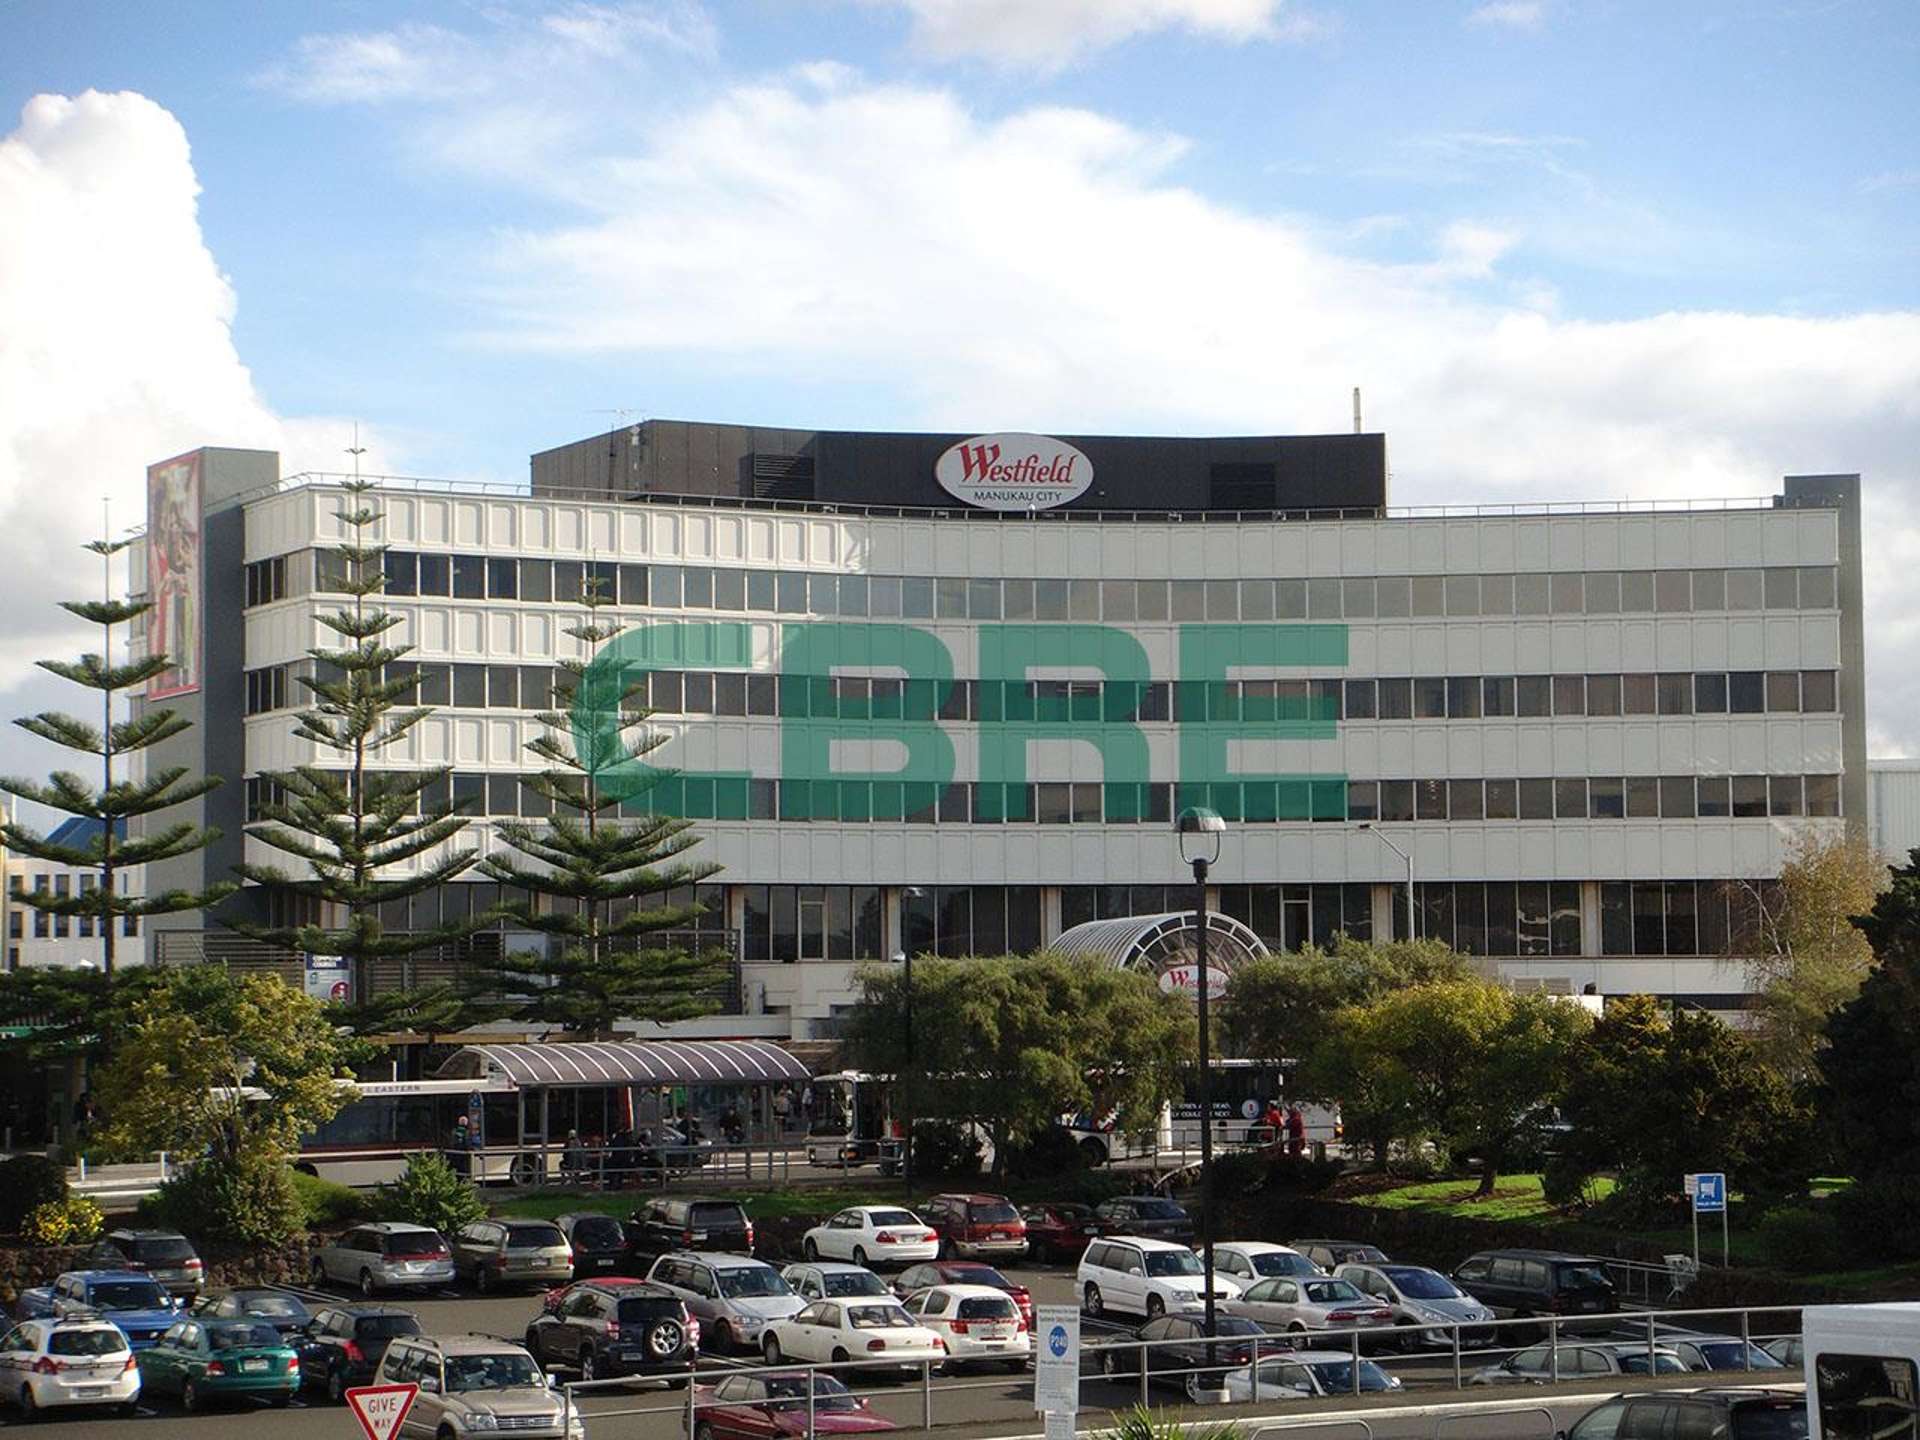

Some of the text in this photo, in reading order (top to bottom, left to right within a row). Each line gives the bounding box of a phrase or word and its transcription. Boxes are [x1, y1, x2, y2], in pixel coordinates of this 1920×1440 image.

[957, 443, 1078, 483] Westfield
[974, 491, 1062, 501] MANUKAU CITY
[368, 1398, 397, 1413] GIVE
[374, 1419, 391, 1429] WAY
